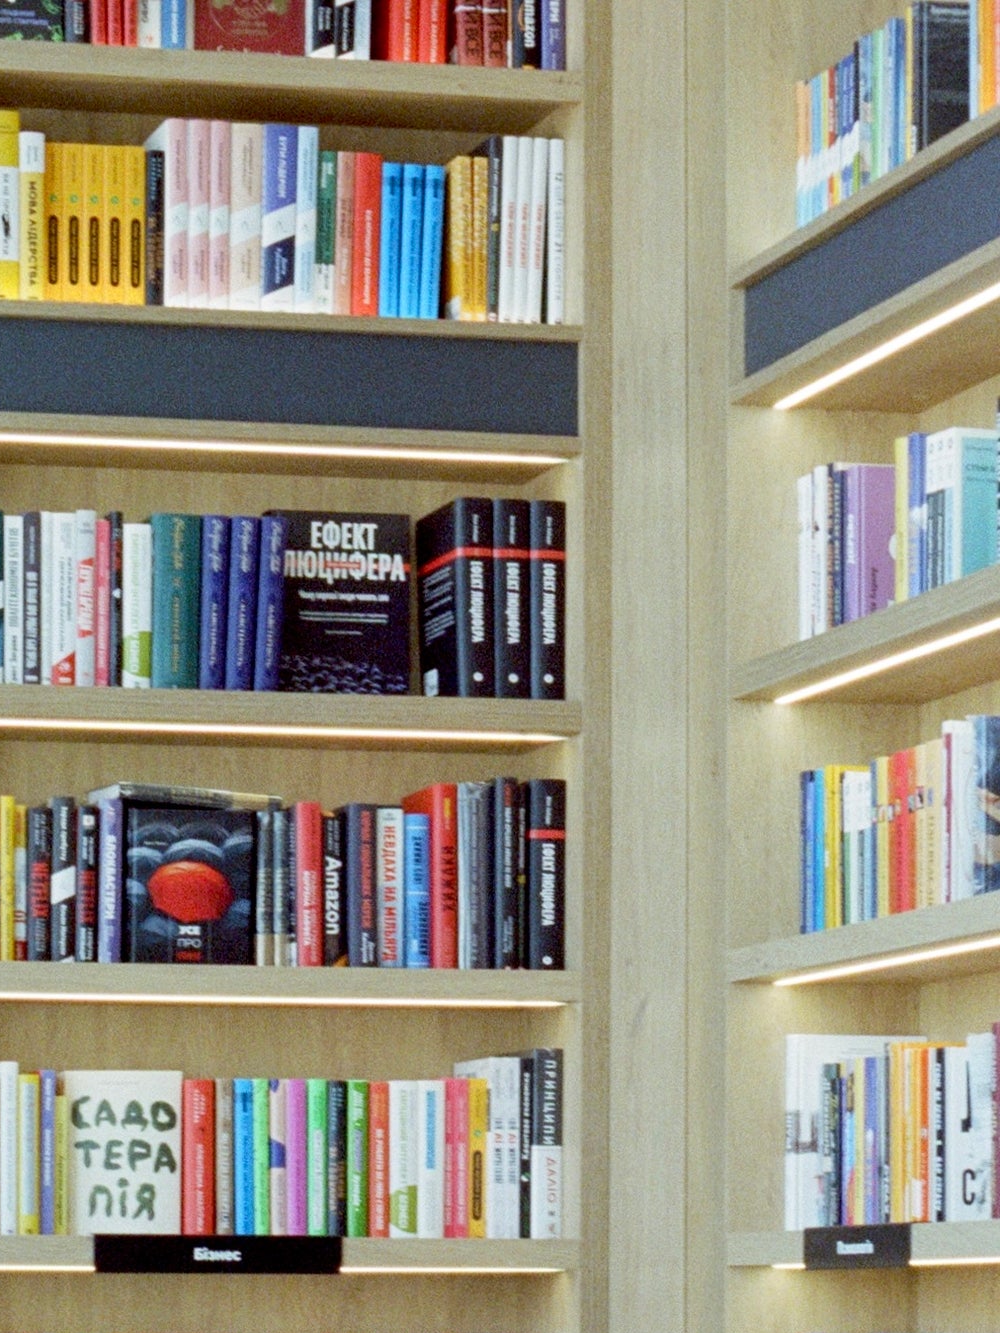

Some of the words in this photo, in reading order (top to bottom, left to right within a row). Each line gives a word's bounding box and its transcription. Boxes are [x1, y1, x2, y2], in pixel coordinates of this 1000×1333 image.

[524, 0, 536, 48] amazon
[27, 181, 37, 215] МОВА
[311, 521, 379, 551] ЕФЕКТ
[284, 550, 406, 584] ЛЮЦИФЕРА
[470, 561, 484, 589] ЕФЕКТ
[507, 562, 520, 590] ЕФЕКТ
[543, 563, 556, 592] ЕФЕКТ
[468, 590, 484, 643] ЛЮЦИФЕРА
[505, 591, 520, 644] ЛЮЦИФЕРА
[541, 592, 556, 645] ЛЮЦИФЕРА
[380, 825, 398, 882] НЕВДАХА
[541, 843, 555, 872] ЕФЕКТ
[31, 862, 48, 918] NETFLIX
[78, 870, 96, 924] NETFLIX
[325, 856, 342, 935] Amazon
[385, 886, 398, 903] НА
[540, 873, 555, 926] ЛЮЦИФЕРА
[381, 906, 398, 962] МІЛЬЯРД
[71, 1096, 177, 1132] САДО
[542, 1060, 557, 1146] ПРИНЦИПИ
[73, 1139, 177, 1174] ТЕРА
[89, 1178, 156, 1221] ПІЯ
[193, 1246, 242, 1262] Бізнес
